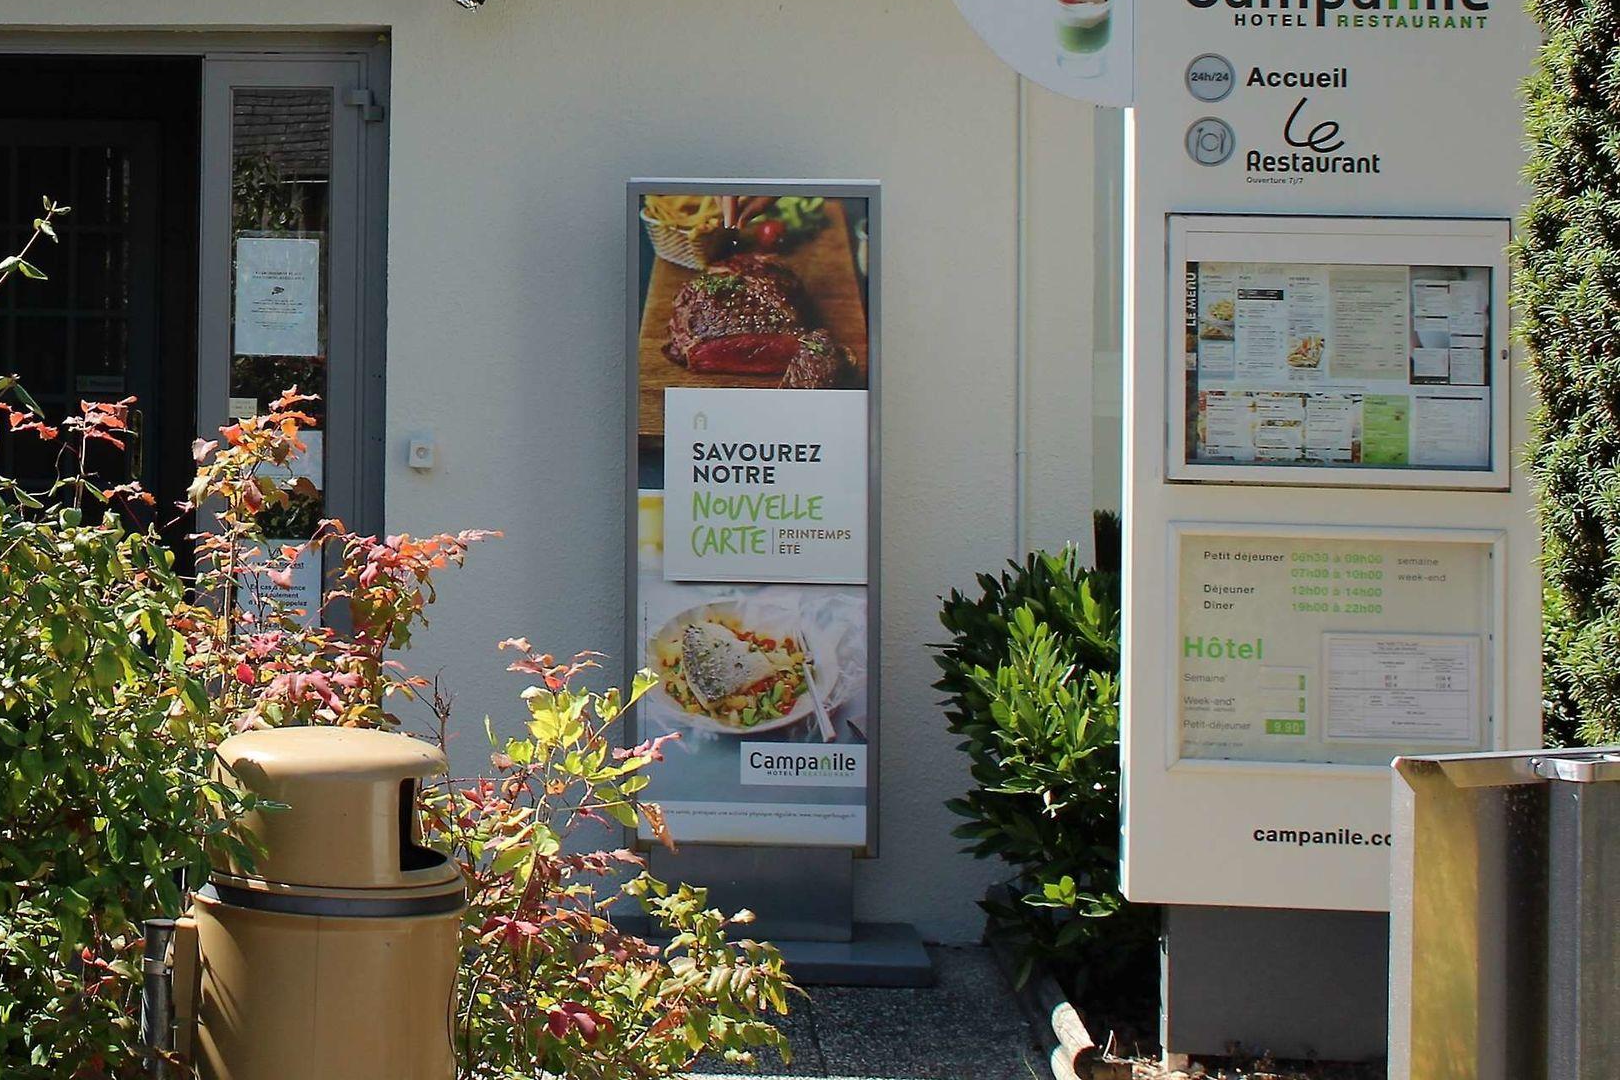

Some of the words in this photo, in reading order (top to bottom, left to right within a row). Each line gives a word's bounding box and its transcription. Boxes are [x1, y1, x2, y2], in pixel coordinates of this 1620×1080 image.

[1234, 13, 1308, 27] HOTEL
[1337, 14, 1487, 29] RESTAURANT
[1190, 71, 1229, 83] 24h/24
[1246, 67, 1347, 88] Accueil
[1283, 97, 1345, 153] Le
[1246, 150, 1380, 174] Restaurant
[1246, 176, 1286, 184] Ouverture
[692, 442, 822, 463] SAVOUREZ
[692, 465, 776, 484] NOTRE
[692, 491, 824, 522] NOUVELLE
[691, 525, 767, 558] CARTE
[778, 529, 852, 541] PRINTEMPS
[778, 542, 801, 555] ÉTÉ
[1203, 551, 1230, 560] Petit
[1234, 551, 1285, 563] déjeuner
[1397, 558, 1440, 566] semaine
[1397, 573, 1447, 582] week-end
[1203, 583, 1255, 594] Déjeuner
[1183, 636, 1263, 660] Hôtel
[749, 751, 856, 776] Campanile
